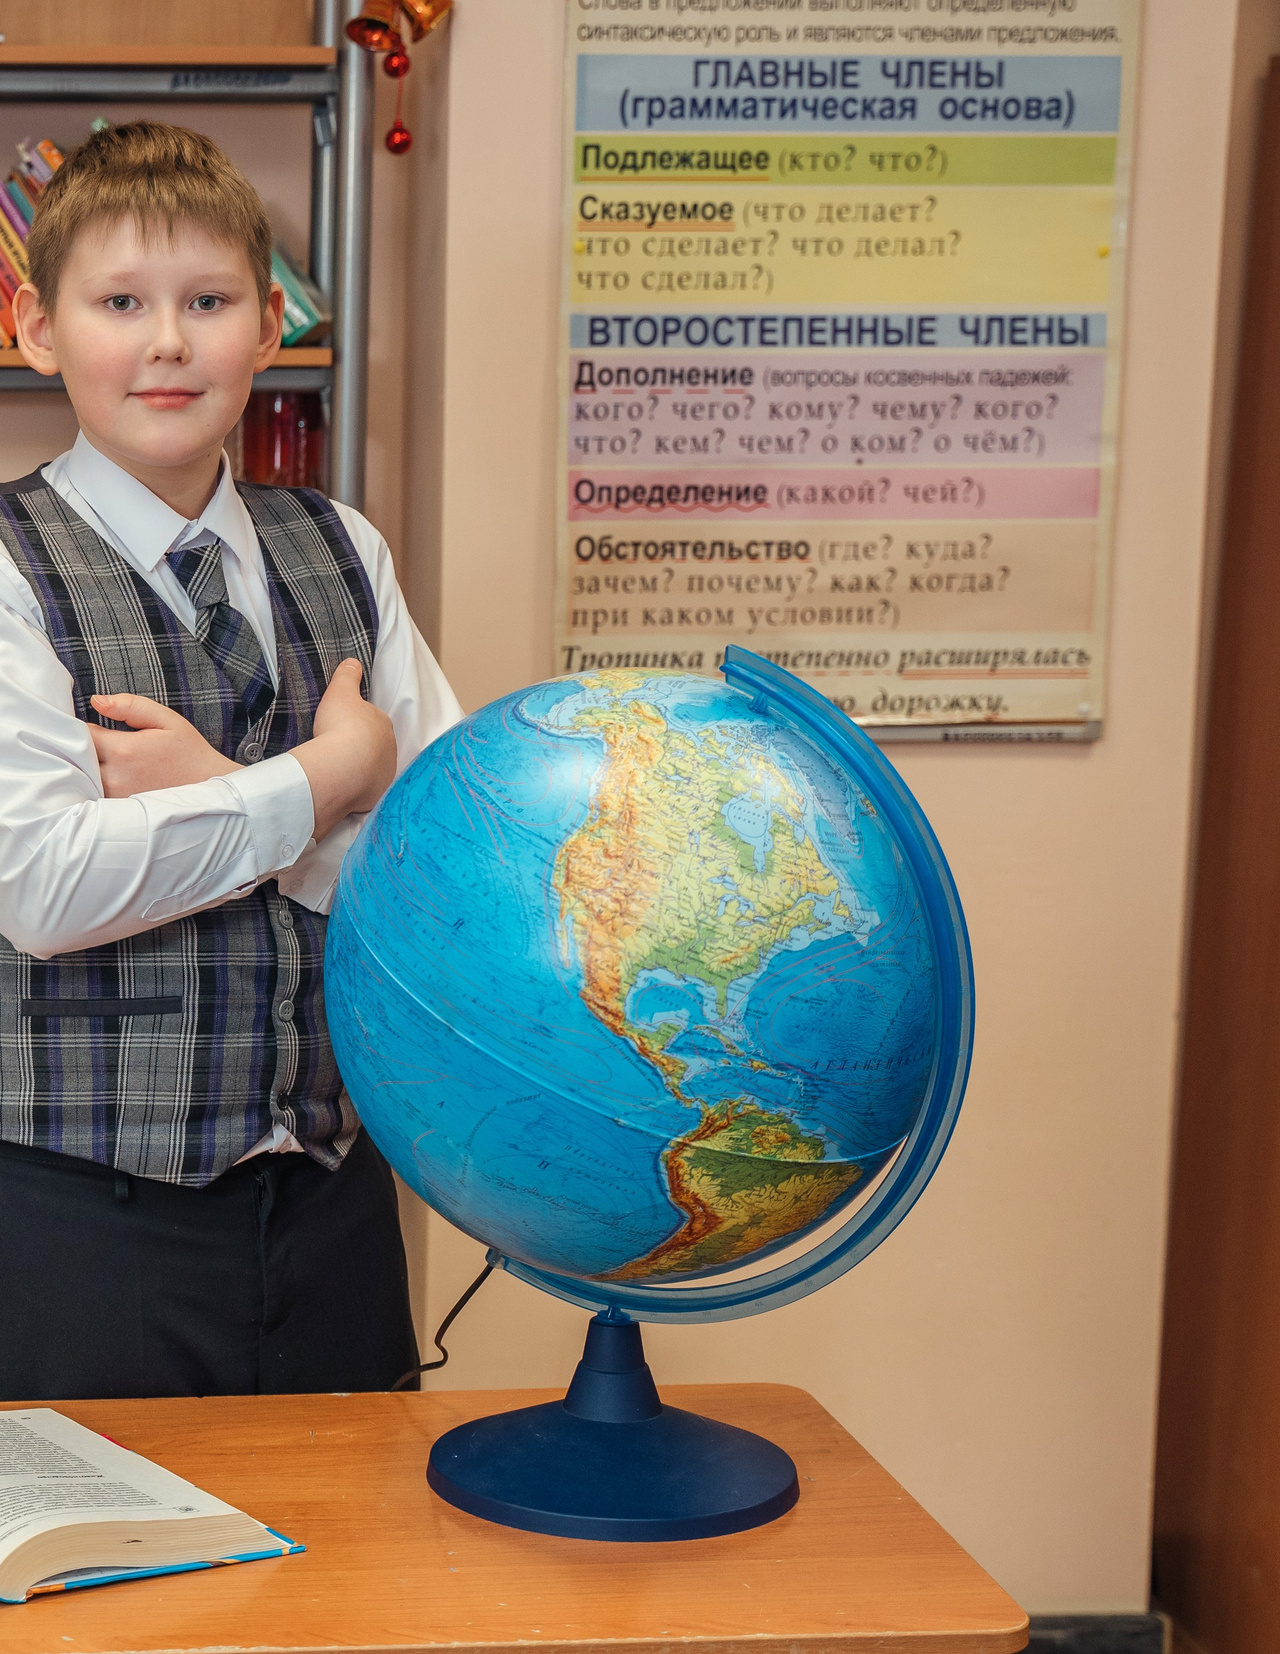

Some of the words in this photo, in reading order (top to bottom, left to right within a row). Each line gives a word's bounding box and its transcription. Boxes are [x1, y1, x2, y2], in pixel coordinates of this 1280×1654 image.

[577, 23, 732, 47] синтаксическую
[734, 25, 781, 47] роль
[786, 25, 798, 42] и
[802, 25, 895, 43] являются
[898, 25, 982, 43] членами
[986, 25, 1122, 47] предложения.
[692, 59, 860, 89] ГЛАВНЫЕ
[881, 59, 1005, 89] ЧЛЕНЫ
[619, 86, 919, 129] (грамматическая
[938, 87, 1075, 129] основа)
[580, 143, 771, 175] Подлежащее
[777, 144, 858, 174] (кто?
[869, 144, 949, 174] что?)
[578, 196, 735, 229] Сказуемое
[742, 200, 806, 228] (что
[816, 195, 939, 228] делает?
[641, 230, 781, 259] сделает?
[792, 235, 845, 257] что
[854, 230, 963, 259] делал?
[577, 268, 630, 291] что
[641, 263, 775, 294] сделал?)
[587, 316, 938, 347] ВТОРОСТЕПЕННЫЕ
[959, 316, 1091, 347] ЧЛЕНЫ
[574, 362, 755, 391] Дополнение
[762, 366, 858, 392] (вопросы
[864, 368, 973, 388] косвенных
[574, 394, 660, 423] кого?
[671, 394, 756, 423] чего?
[768, 393, 861, 430] кому?
[871, 393, 964, 430] чему?
[972, 392, 1060, 422] кого?
[573, 427, 642, 455] что?
[654, 427, 726, 456] кем?
[737, 426, 812, 455] чем?
[820, 433, 840, 455] о
[849, 426, 925, 455] ком?
[932, 433, 953, 455] о
[963, 425, 1047, 459] чём?)
[574, 479, 769, 507] Определение
[776, 476, 891, 506] (какой?
[902, 476, 987, 508] чей?)
[574, 535, 811, 561] Обстоятельство
[817, 533, 895, 563] (где?
[905, 533, 993, 564] куда?
[572, 567, 675, 596] зачем?
[686, 567, 820, 599] почему?
[829, 567, 898, 595] как?
[908, 566, 1011, 596] когда?
[571, 605, 630, 634] при
[641, 605, 735, 628] каком
[747, 598, 902, 635] условии?)
[561, 645, 705, 675] Тропинка
[900, 645, 1093, 675] расширялась
[870, 692, 1011, 717] дорожку.
